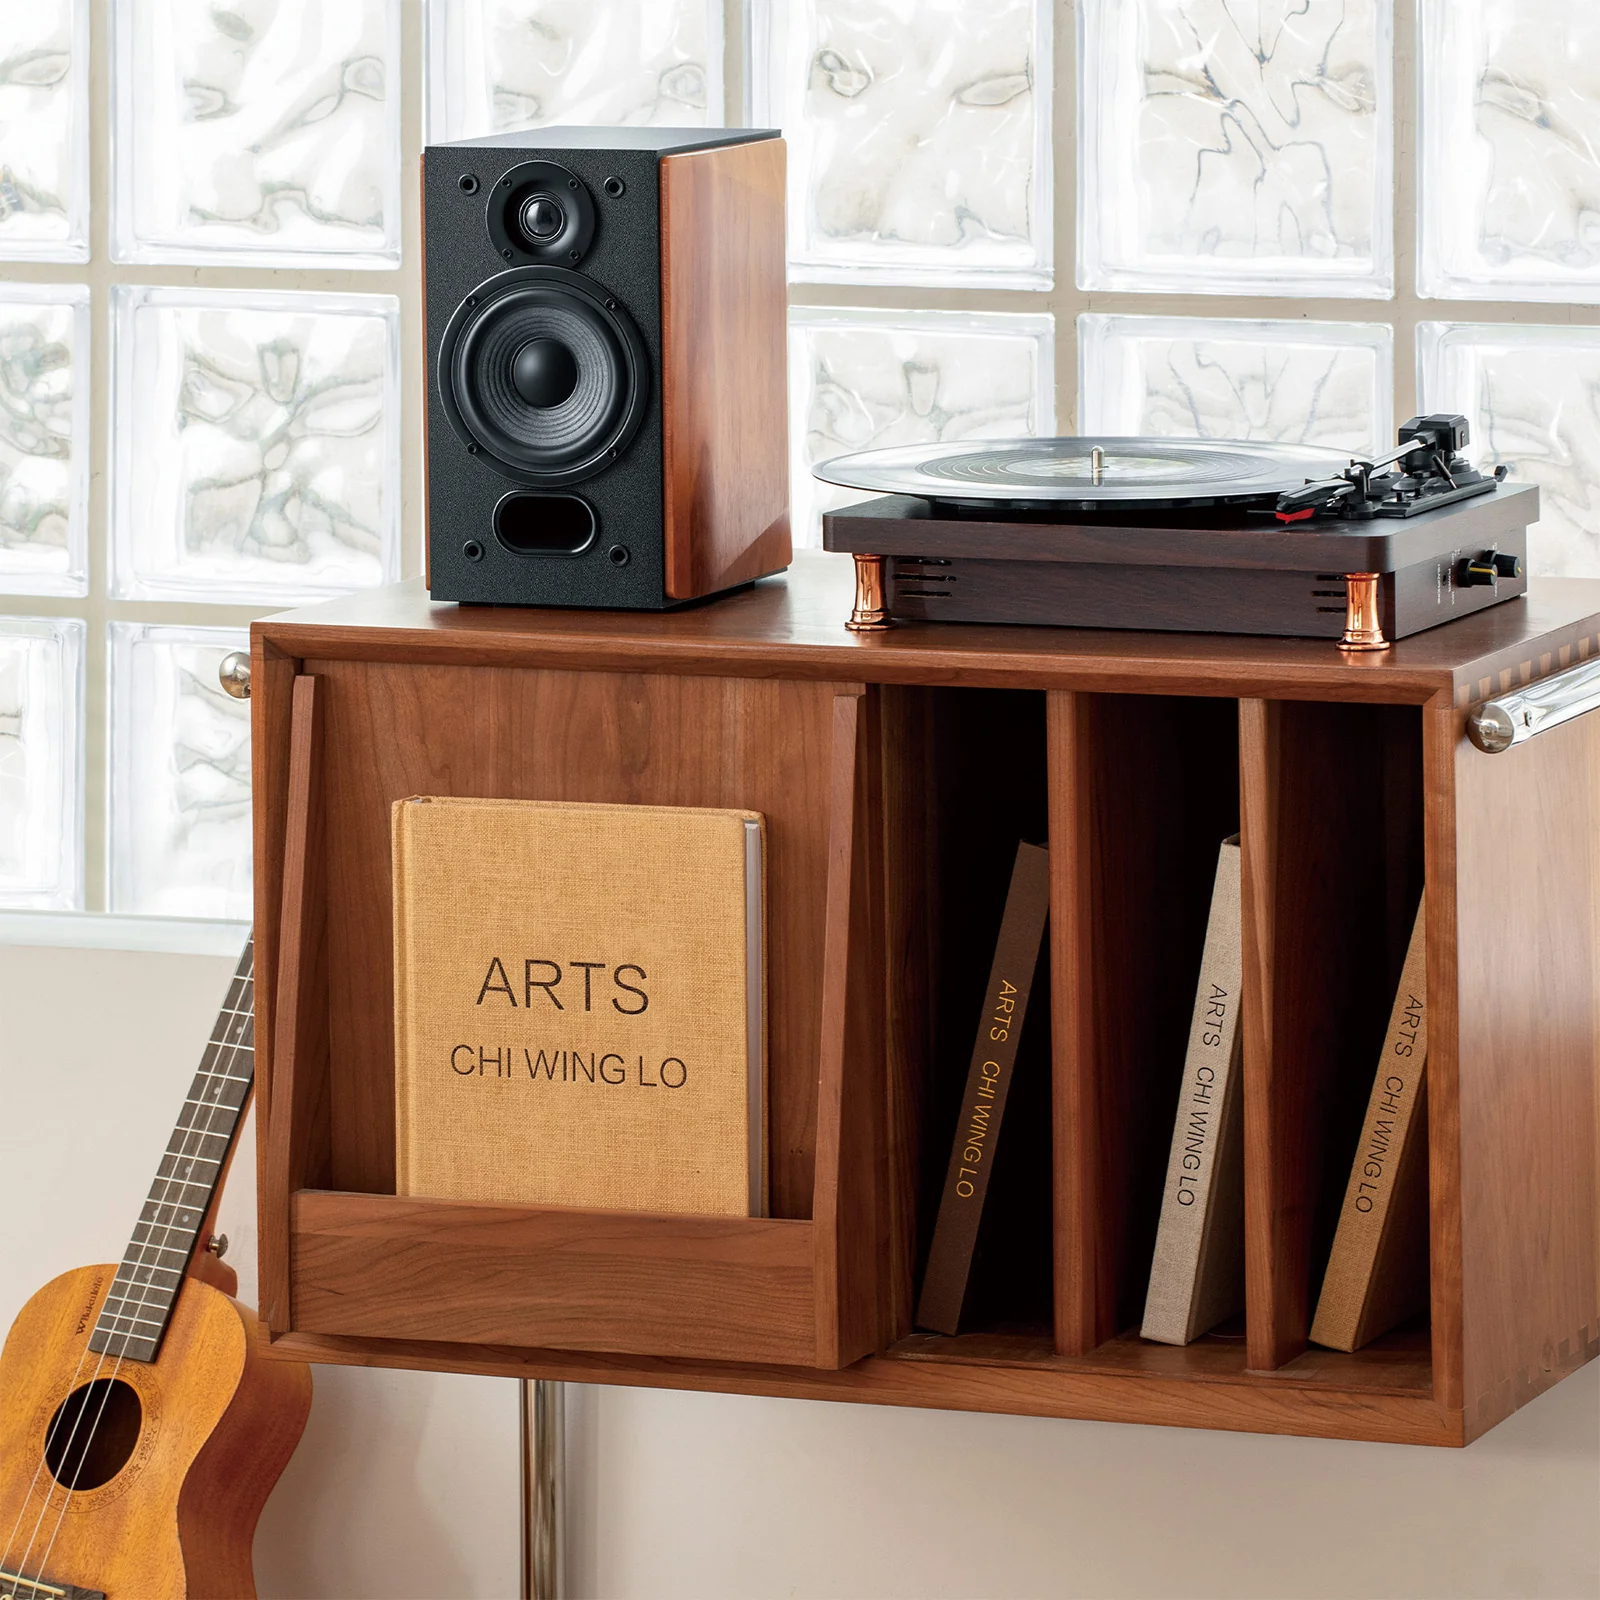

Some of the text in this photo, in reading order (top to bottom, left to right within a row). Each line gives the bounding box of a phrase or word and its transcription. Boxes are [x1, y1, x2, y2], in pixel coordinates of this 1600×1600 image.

[451, 1044, 687, 1088] CHI WING LO
[476, 957, 649, 1014] ARTS
[956, 979, 1017, 1197] ARTS CHI WING LO
[1177, 983, 1228, 1206] ARTS CHI WING LO
[1355, 994, 1424, 1213] ARTS CHI WING LO
